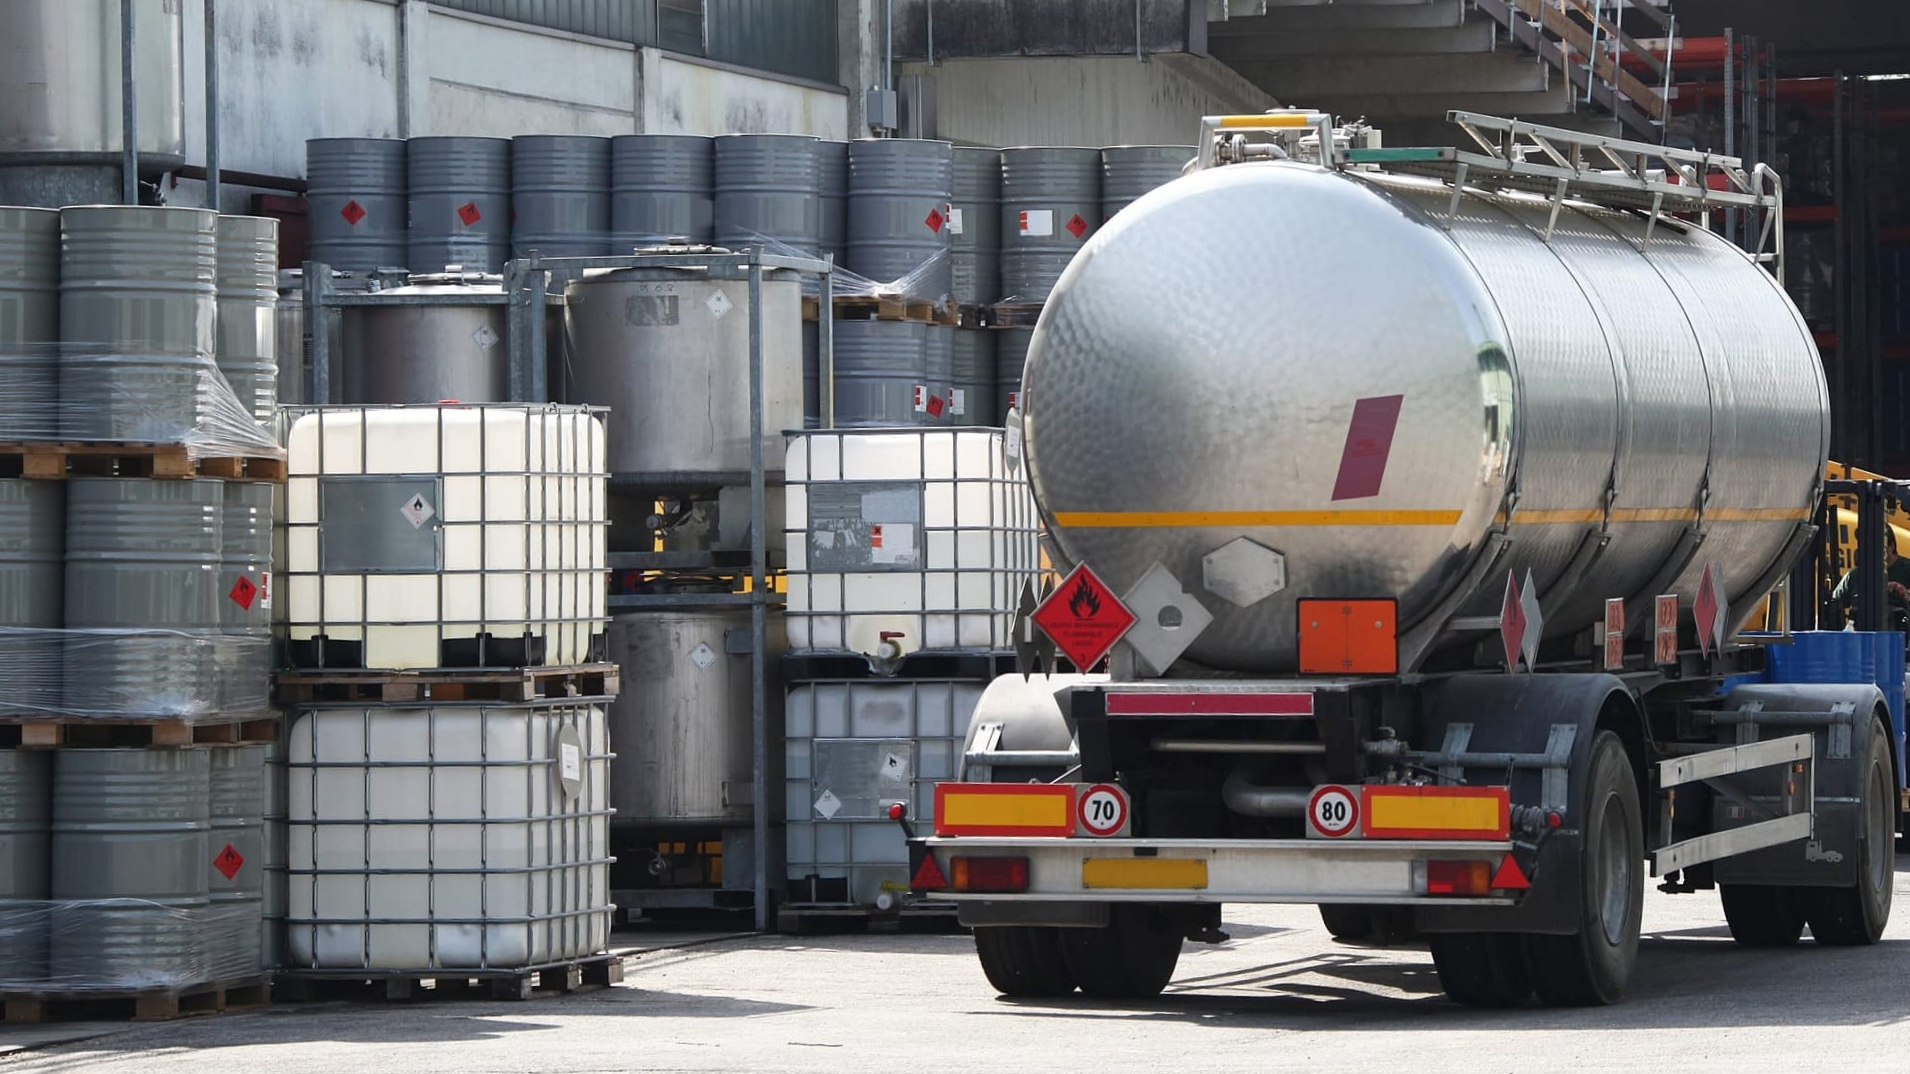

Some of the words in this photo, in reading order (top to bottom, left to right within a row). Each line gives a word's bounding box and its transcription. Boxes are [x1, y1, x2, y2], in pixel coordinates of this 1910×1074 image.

[1080, 653, 1086, 663] 3
[1092, 800, 1115, 821] 70
[1322, 801, 1346, 821] 80
